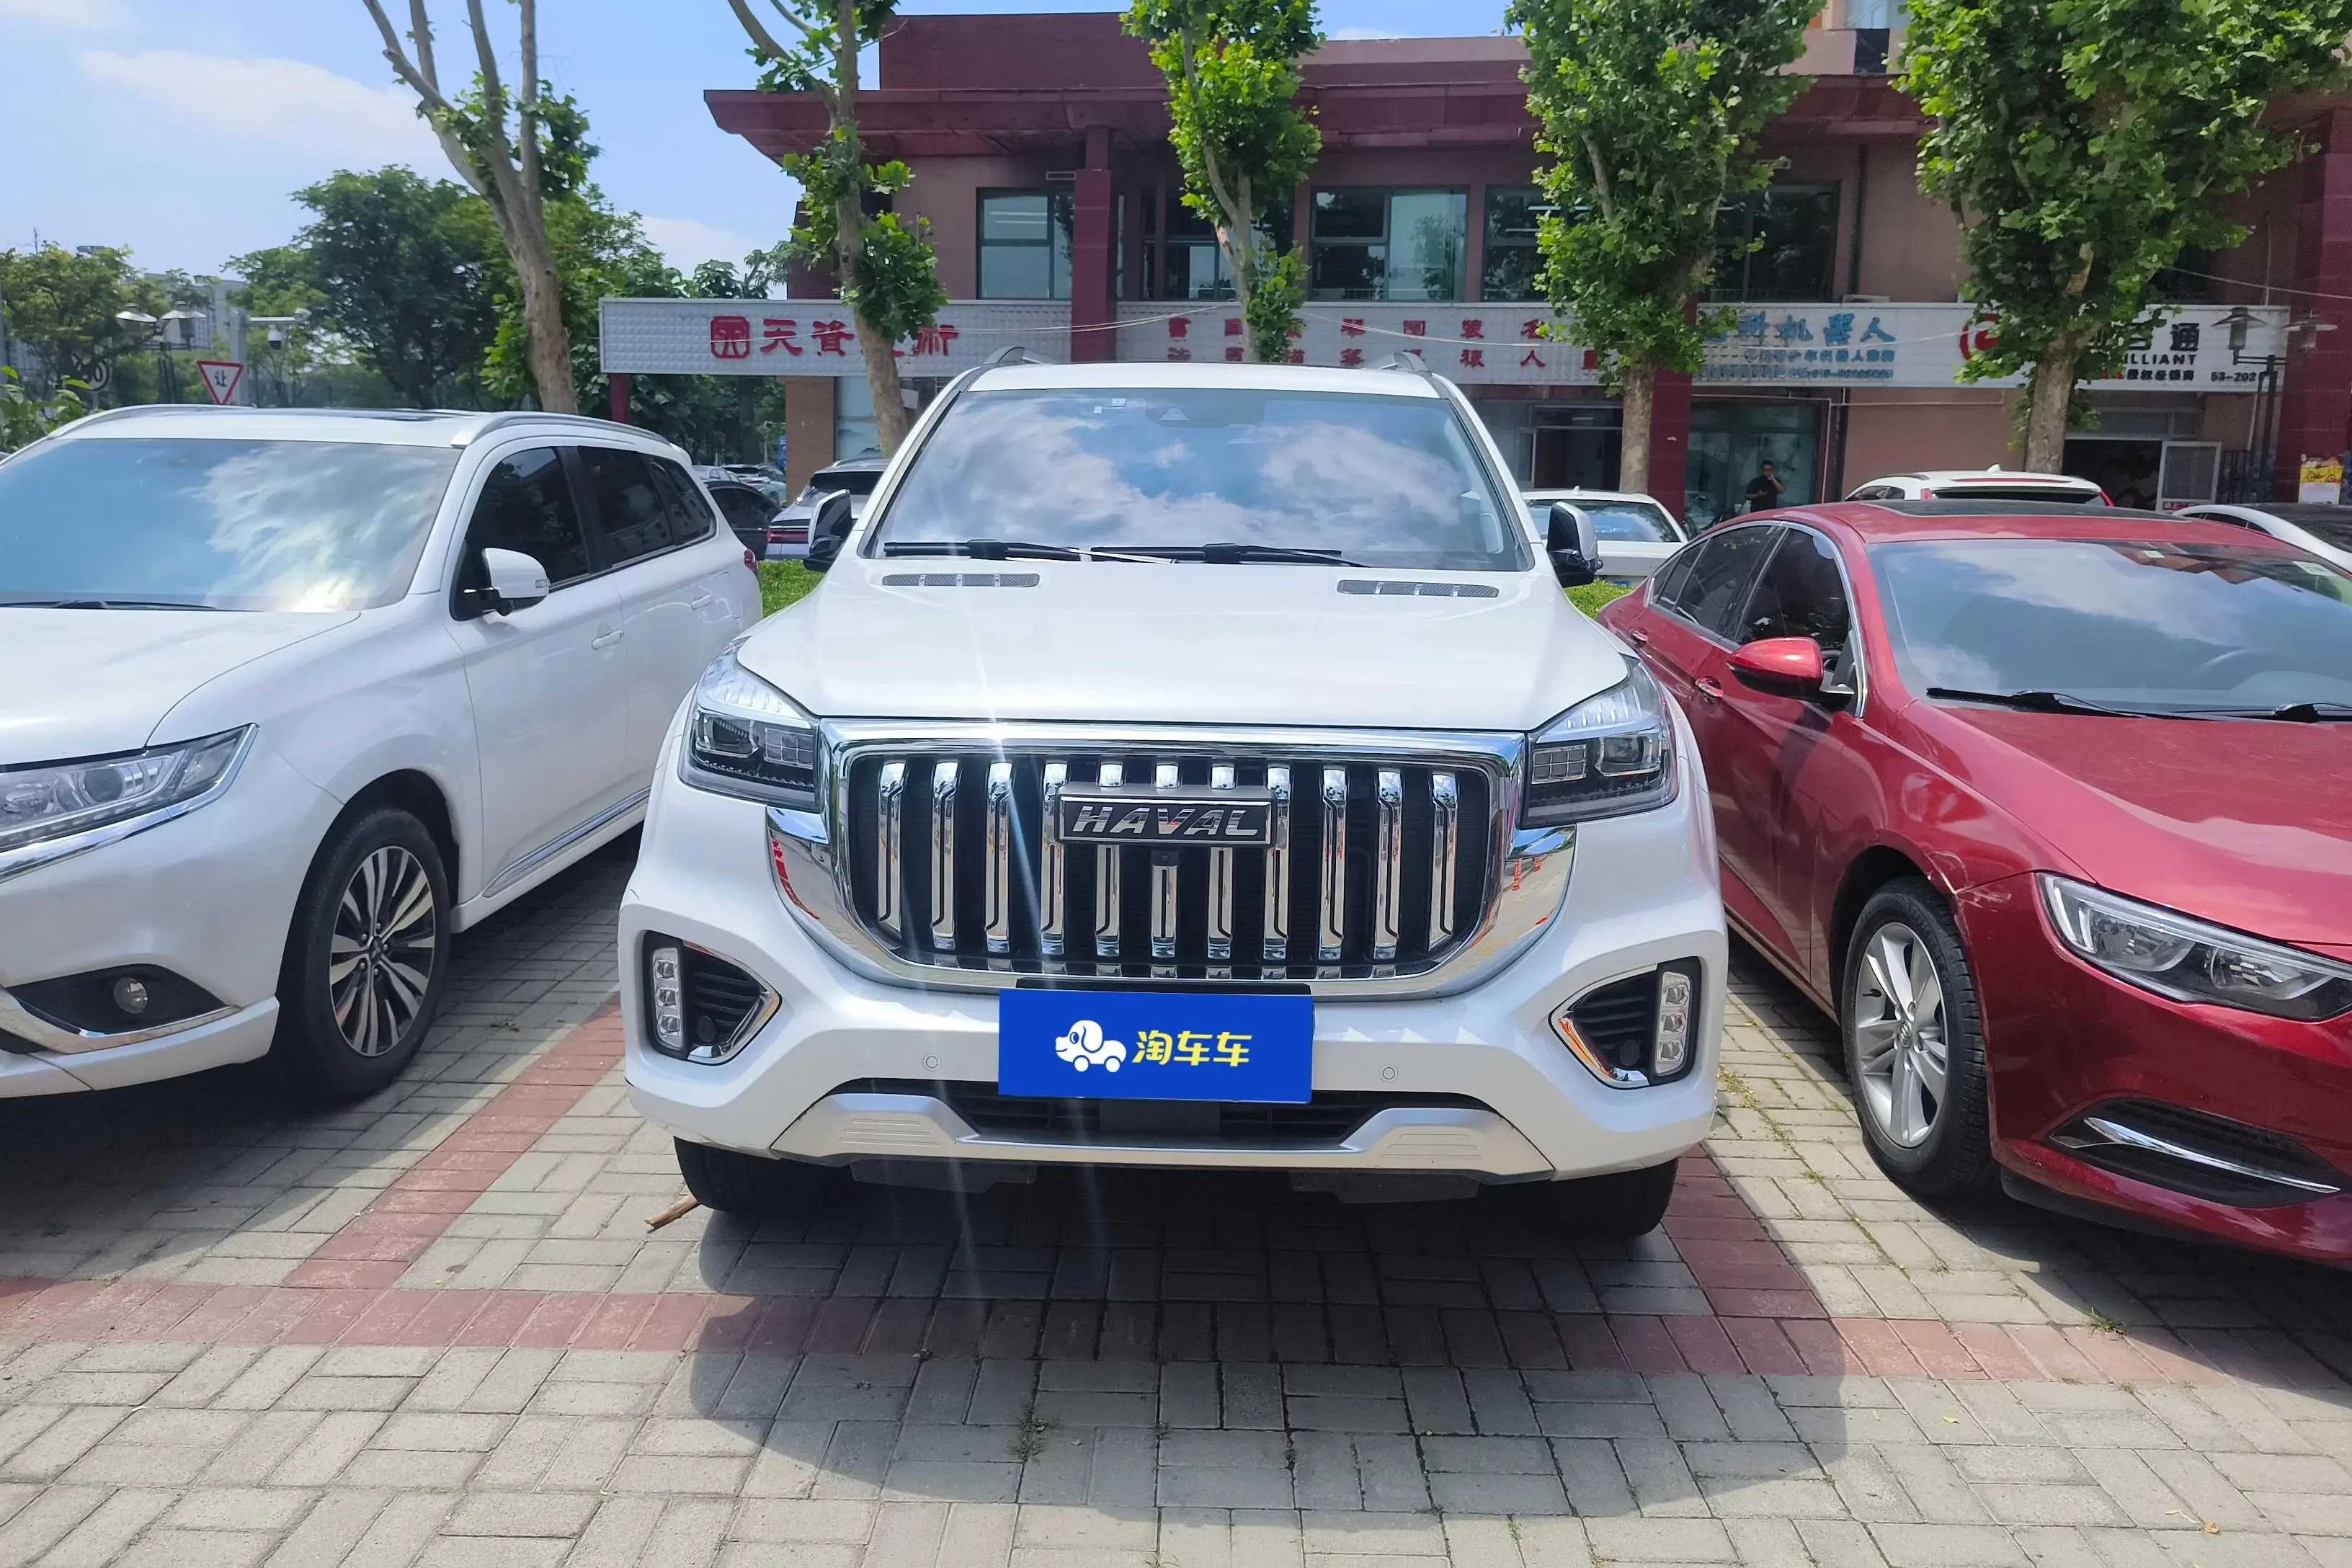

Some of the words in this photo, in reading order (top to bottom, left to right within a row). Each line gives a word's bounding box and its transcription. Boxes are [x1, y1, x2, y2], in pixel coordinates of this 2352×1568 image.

[760, 318, 959, 357] 天資術
[1703, 312, 1897, 346] 科机器人
[2124, 354, 2196, 365] ILLIANT
[213, 370, 226, 387] 让
[1072, 806, 1258, 836] HAVAL
